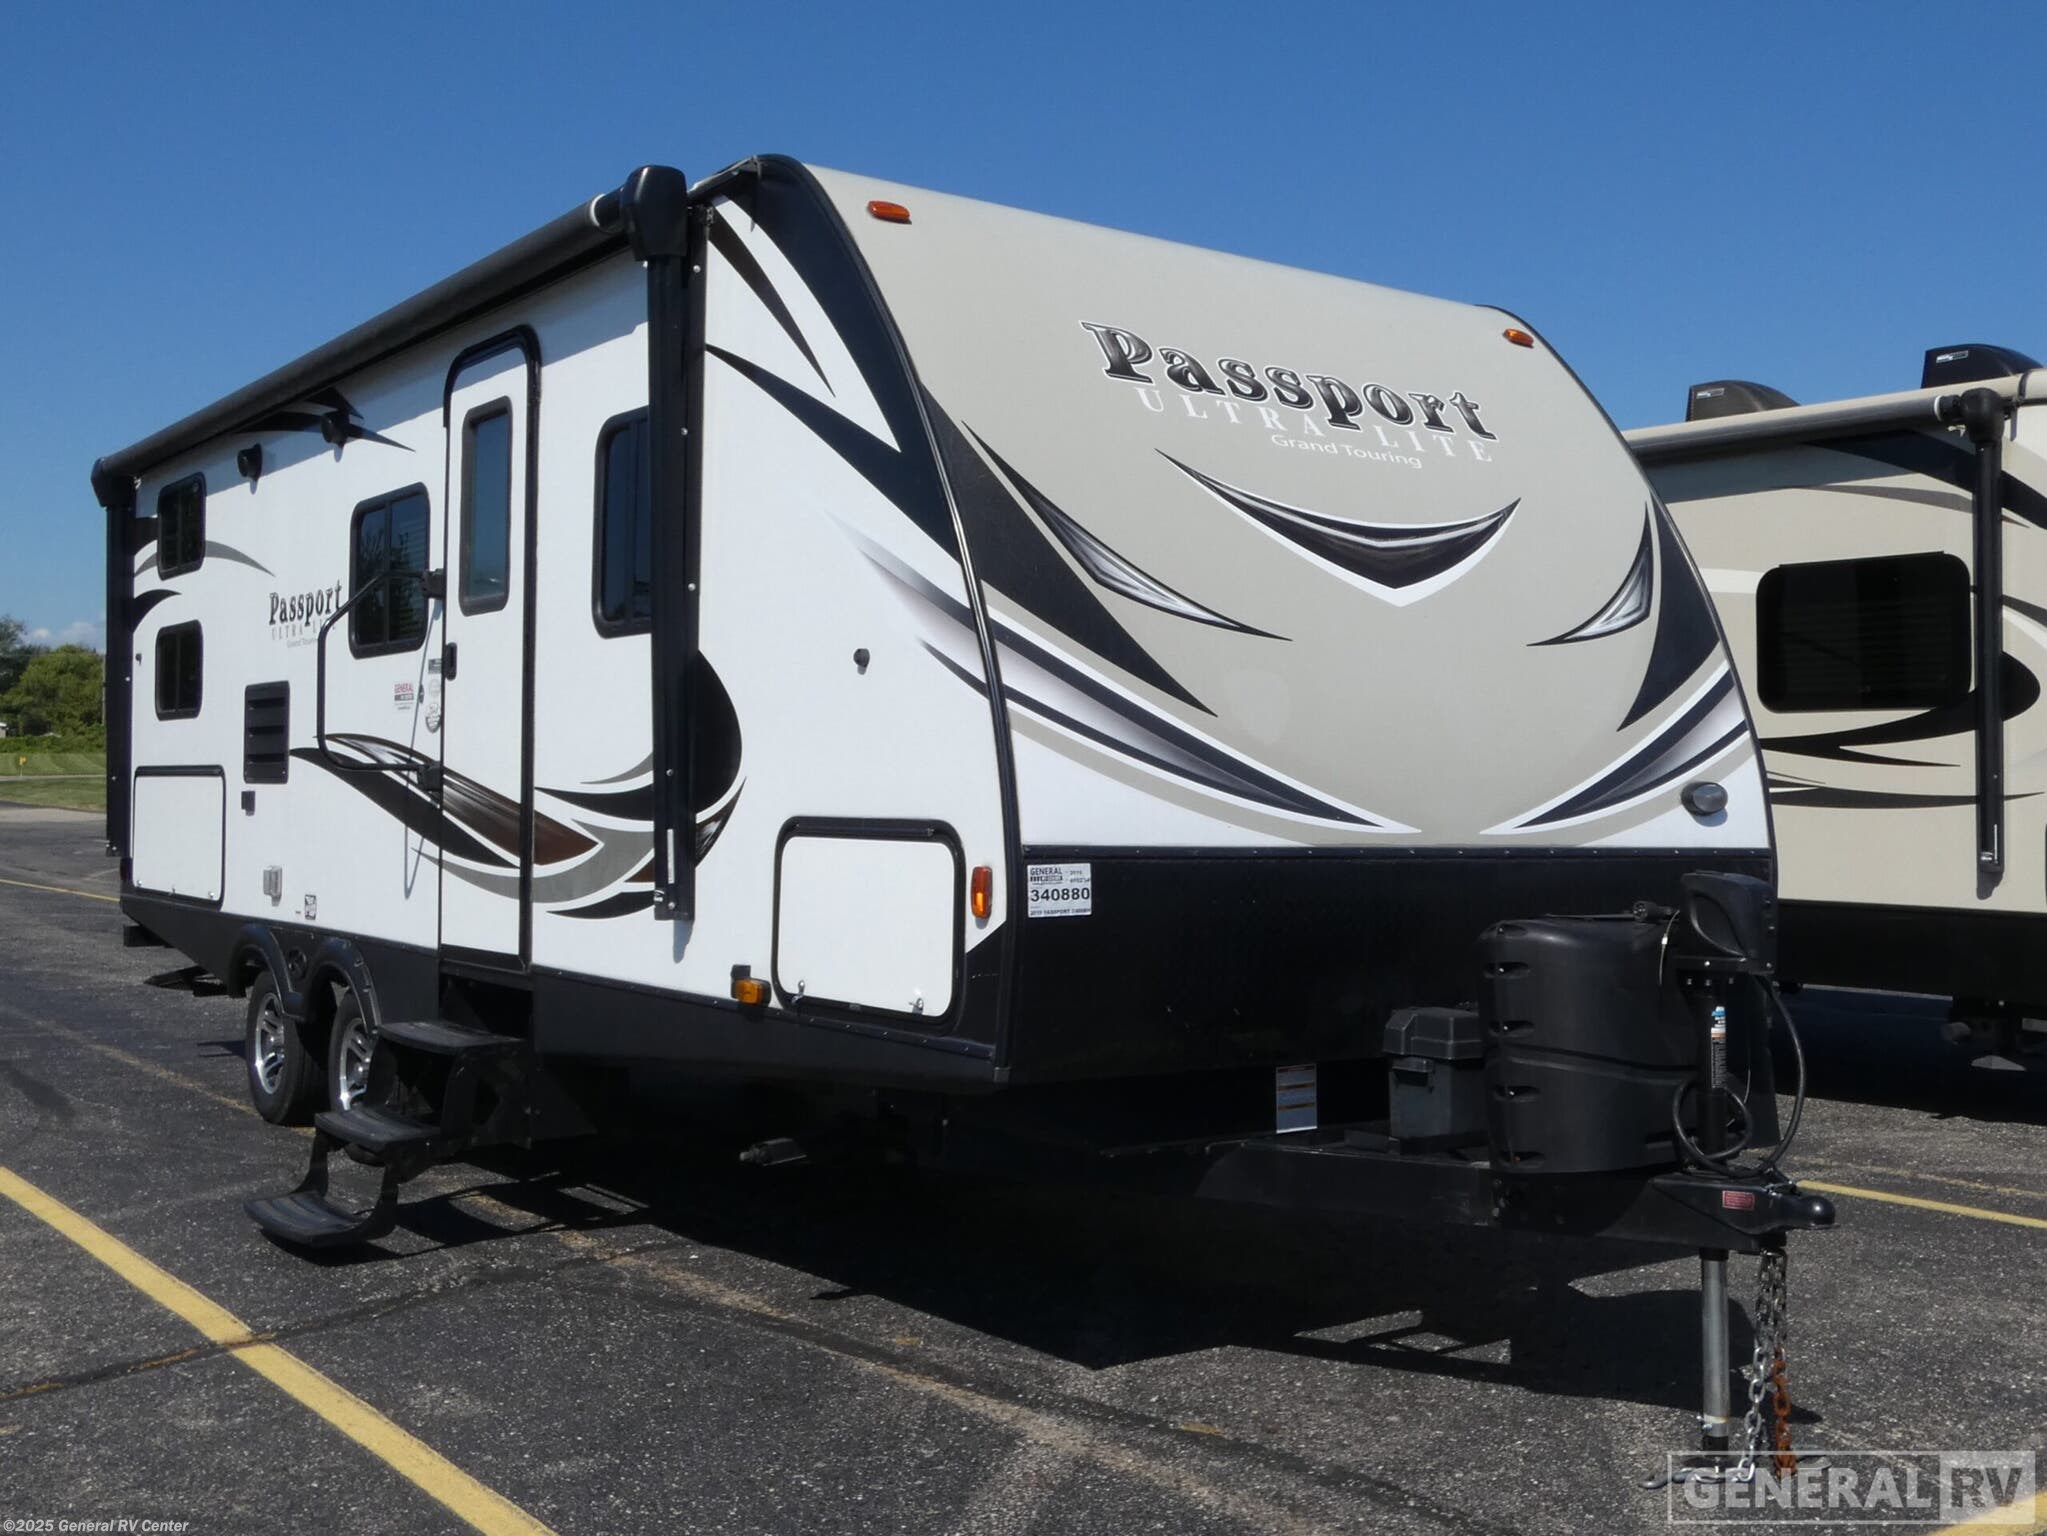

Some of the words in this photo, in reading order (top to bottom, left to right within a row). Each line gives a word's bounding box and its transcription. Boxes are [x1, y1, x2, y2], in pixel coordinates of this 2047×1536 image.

[1081, 321, 1498, 441] Passport
[1133, 387, 1327, 438] ULTRA
[1373, 424, 1493, 463] LITE
[1271, 434, 1338, 455] Grand
[1342, 444, 1422, 469] Touring
[269, 579, 342, 627] Passport
[1030, 867, 1063, 876] GENERAL
[1031, 887, 1090, 902] 340880
